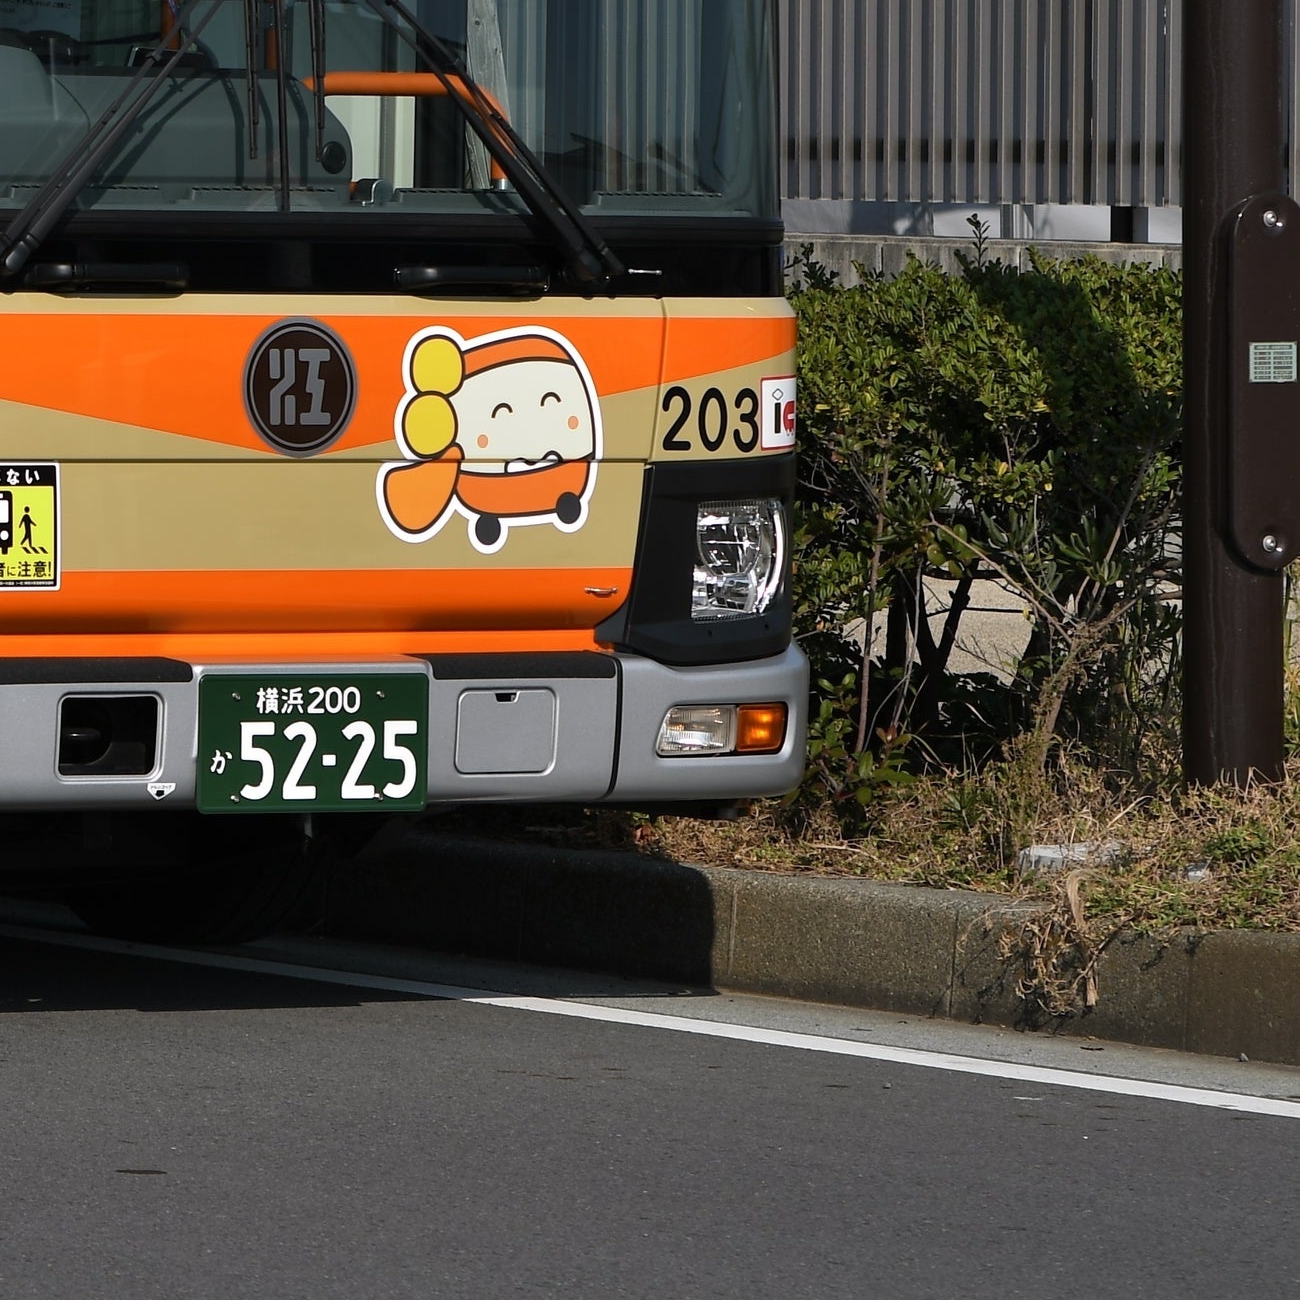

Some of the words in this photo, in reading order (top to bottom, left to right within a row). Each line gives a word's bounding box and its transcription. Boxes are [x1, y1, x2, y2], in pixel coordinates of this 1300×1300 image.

[662, 385, 759, 453] 203
[210, 749, 233, 775] か
[240, 720, 418, 800] 52-25
